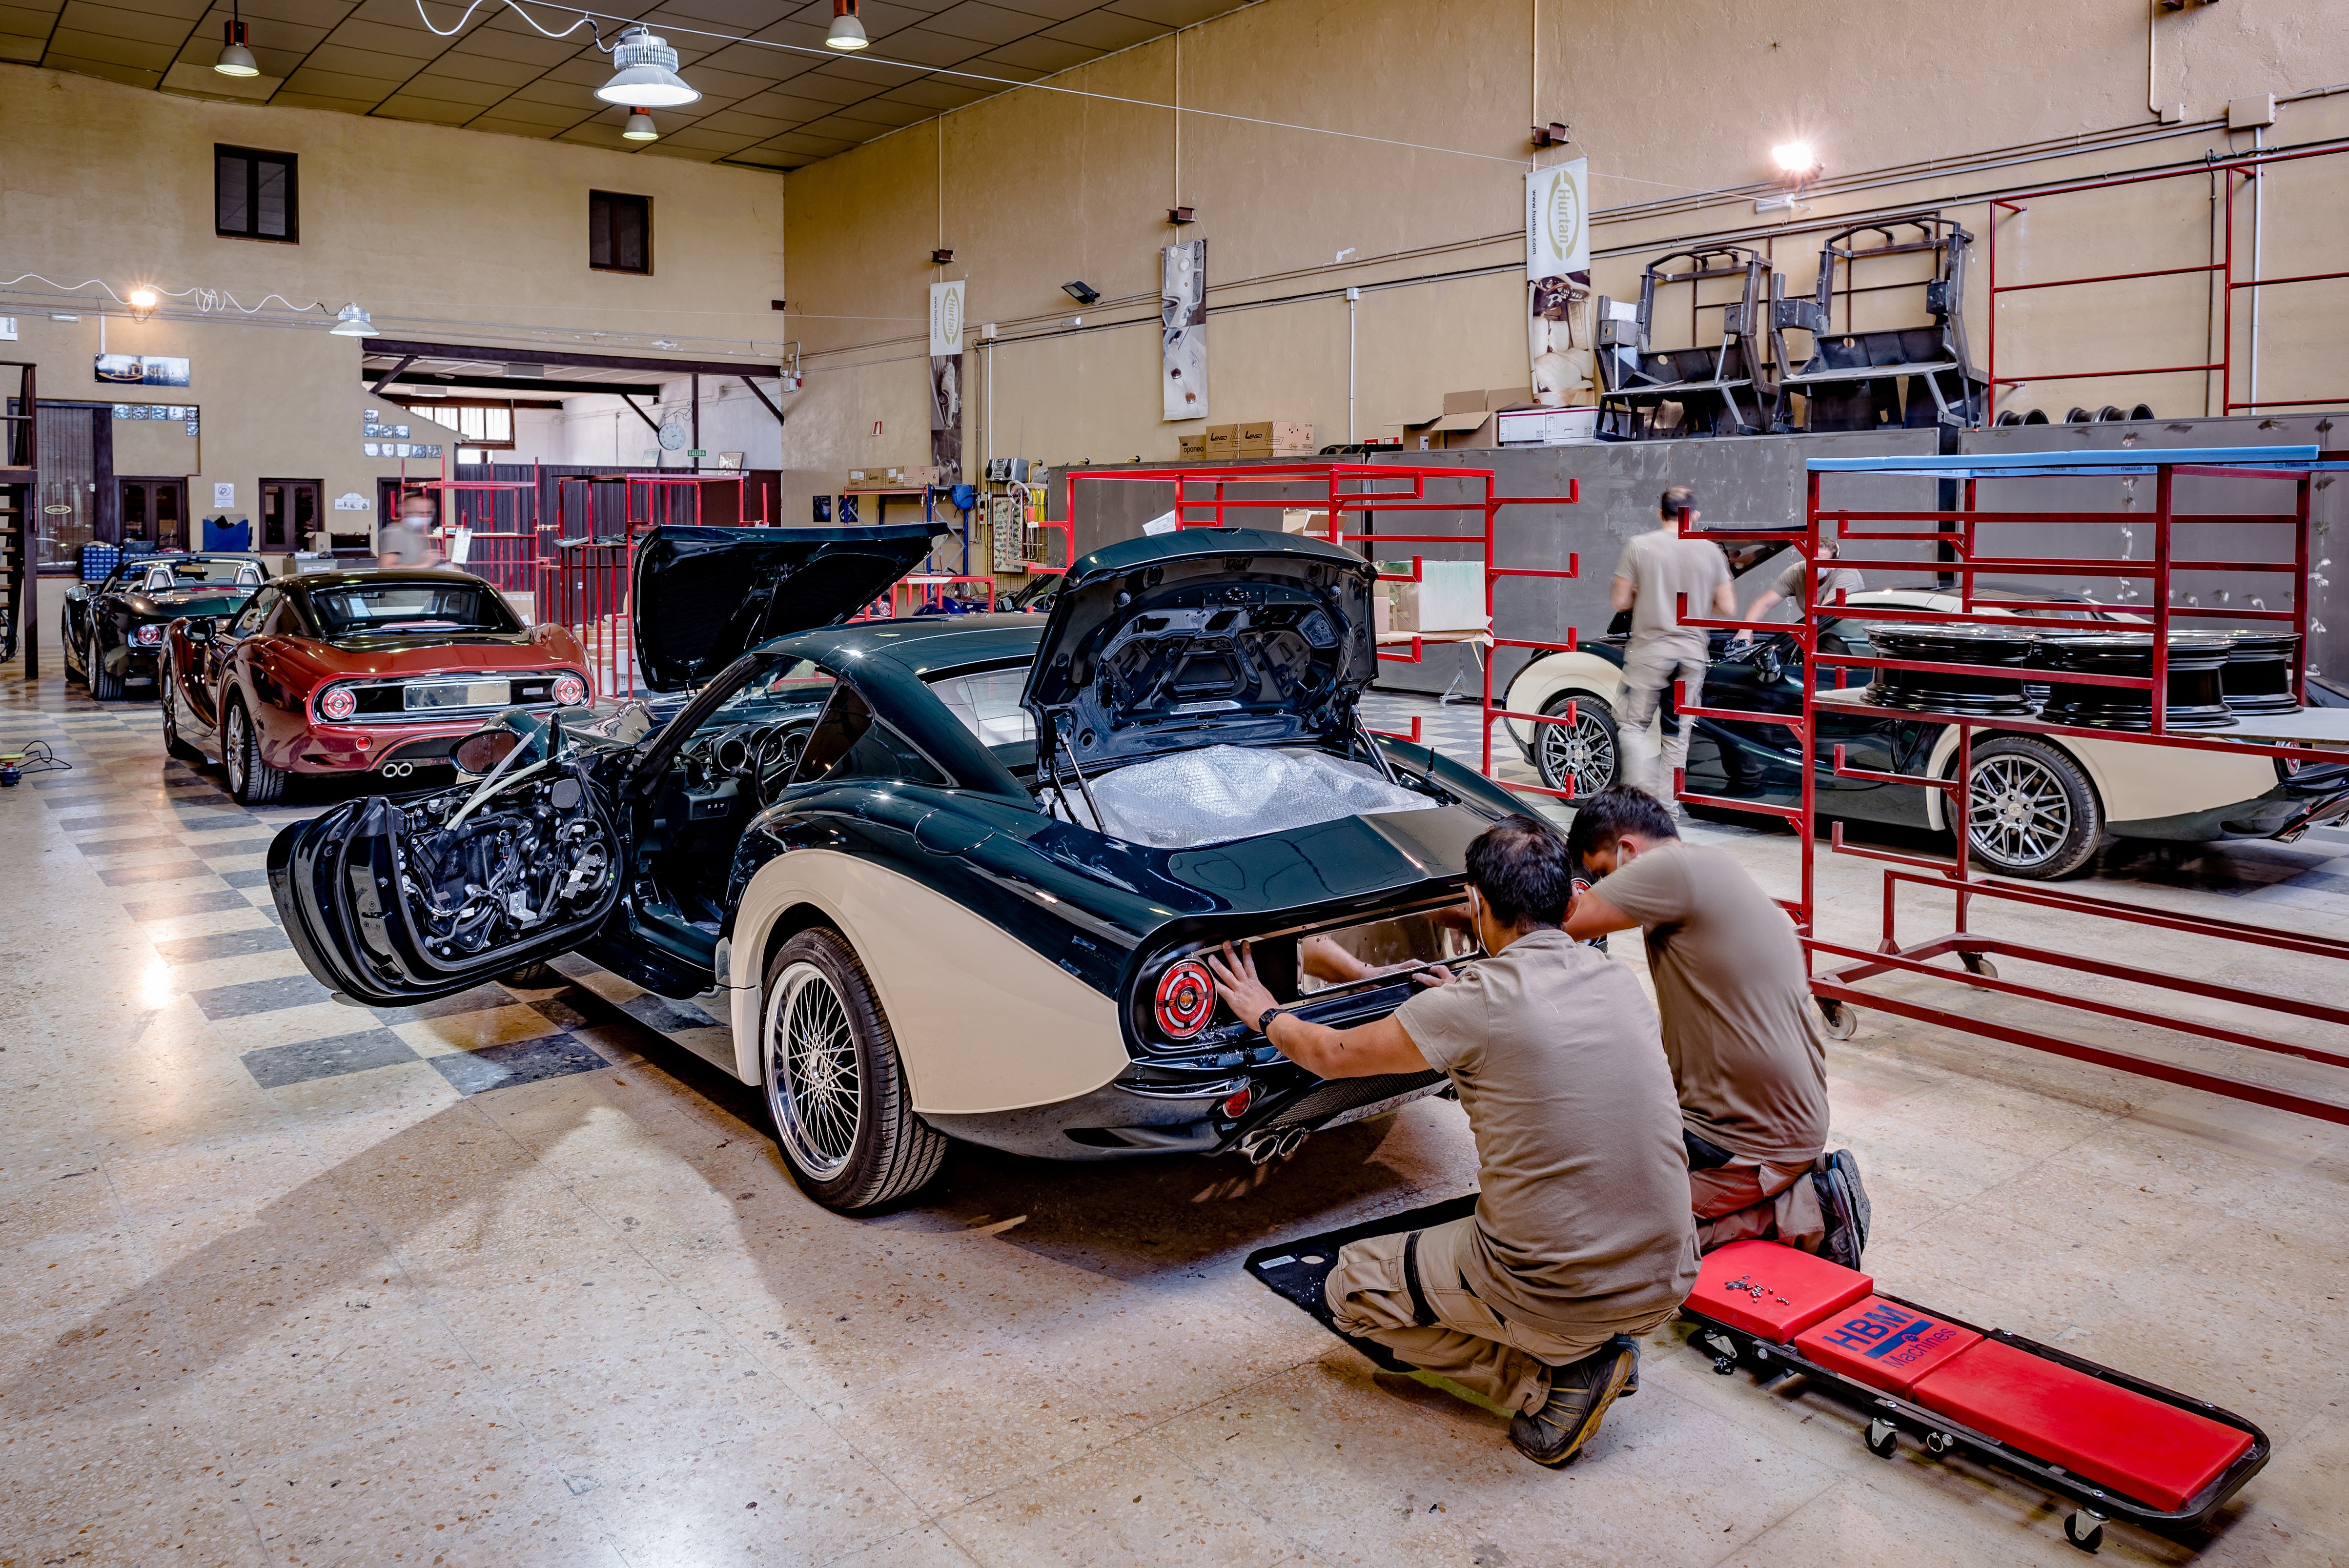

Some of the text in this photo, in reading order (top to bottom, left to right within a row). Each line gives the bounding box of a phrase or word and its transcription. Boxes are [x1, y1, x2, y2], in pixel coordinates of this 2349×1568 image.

[1558, 189, 1570, 243] Hurtan
[1210, 432, 1227, 441] LENSO
[1245, 430, 1263, 439] LENSO
[1184, 446, 1204, 455] oponeo
[1821, 1304, 1915, 1351] HBM
[1881, 1328, 1957, 1369] Machines
